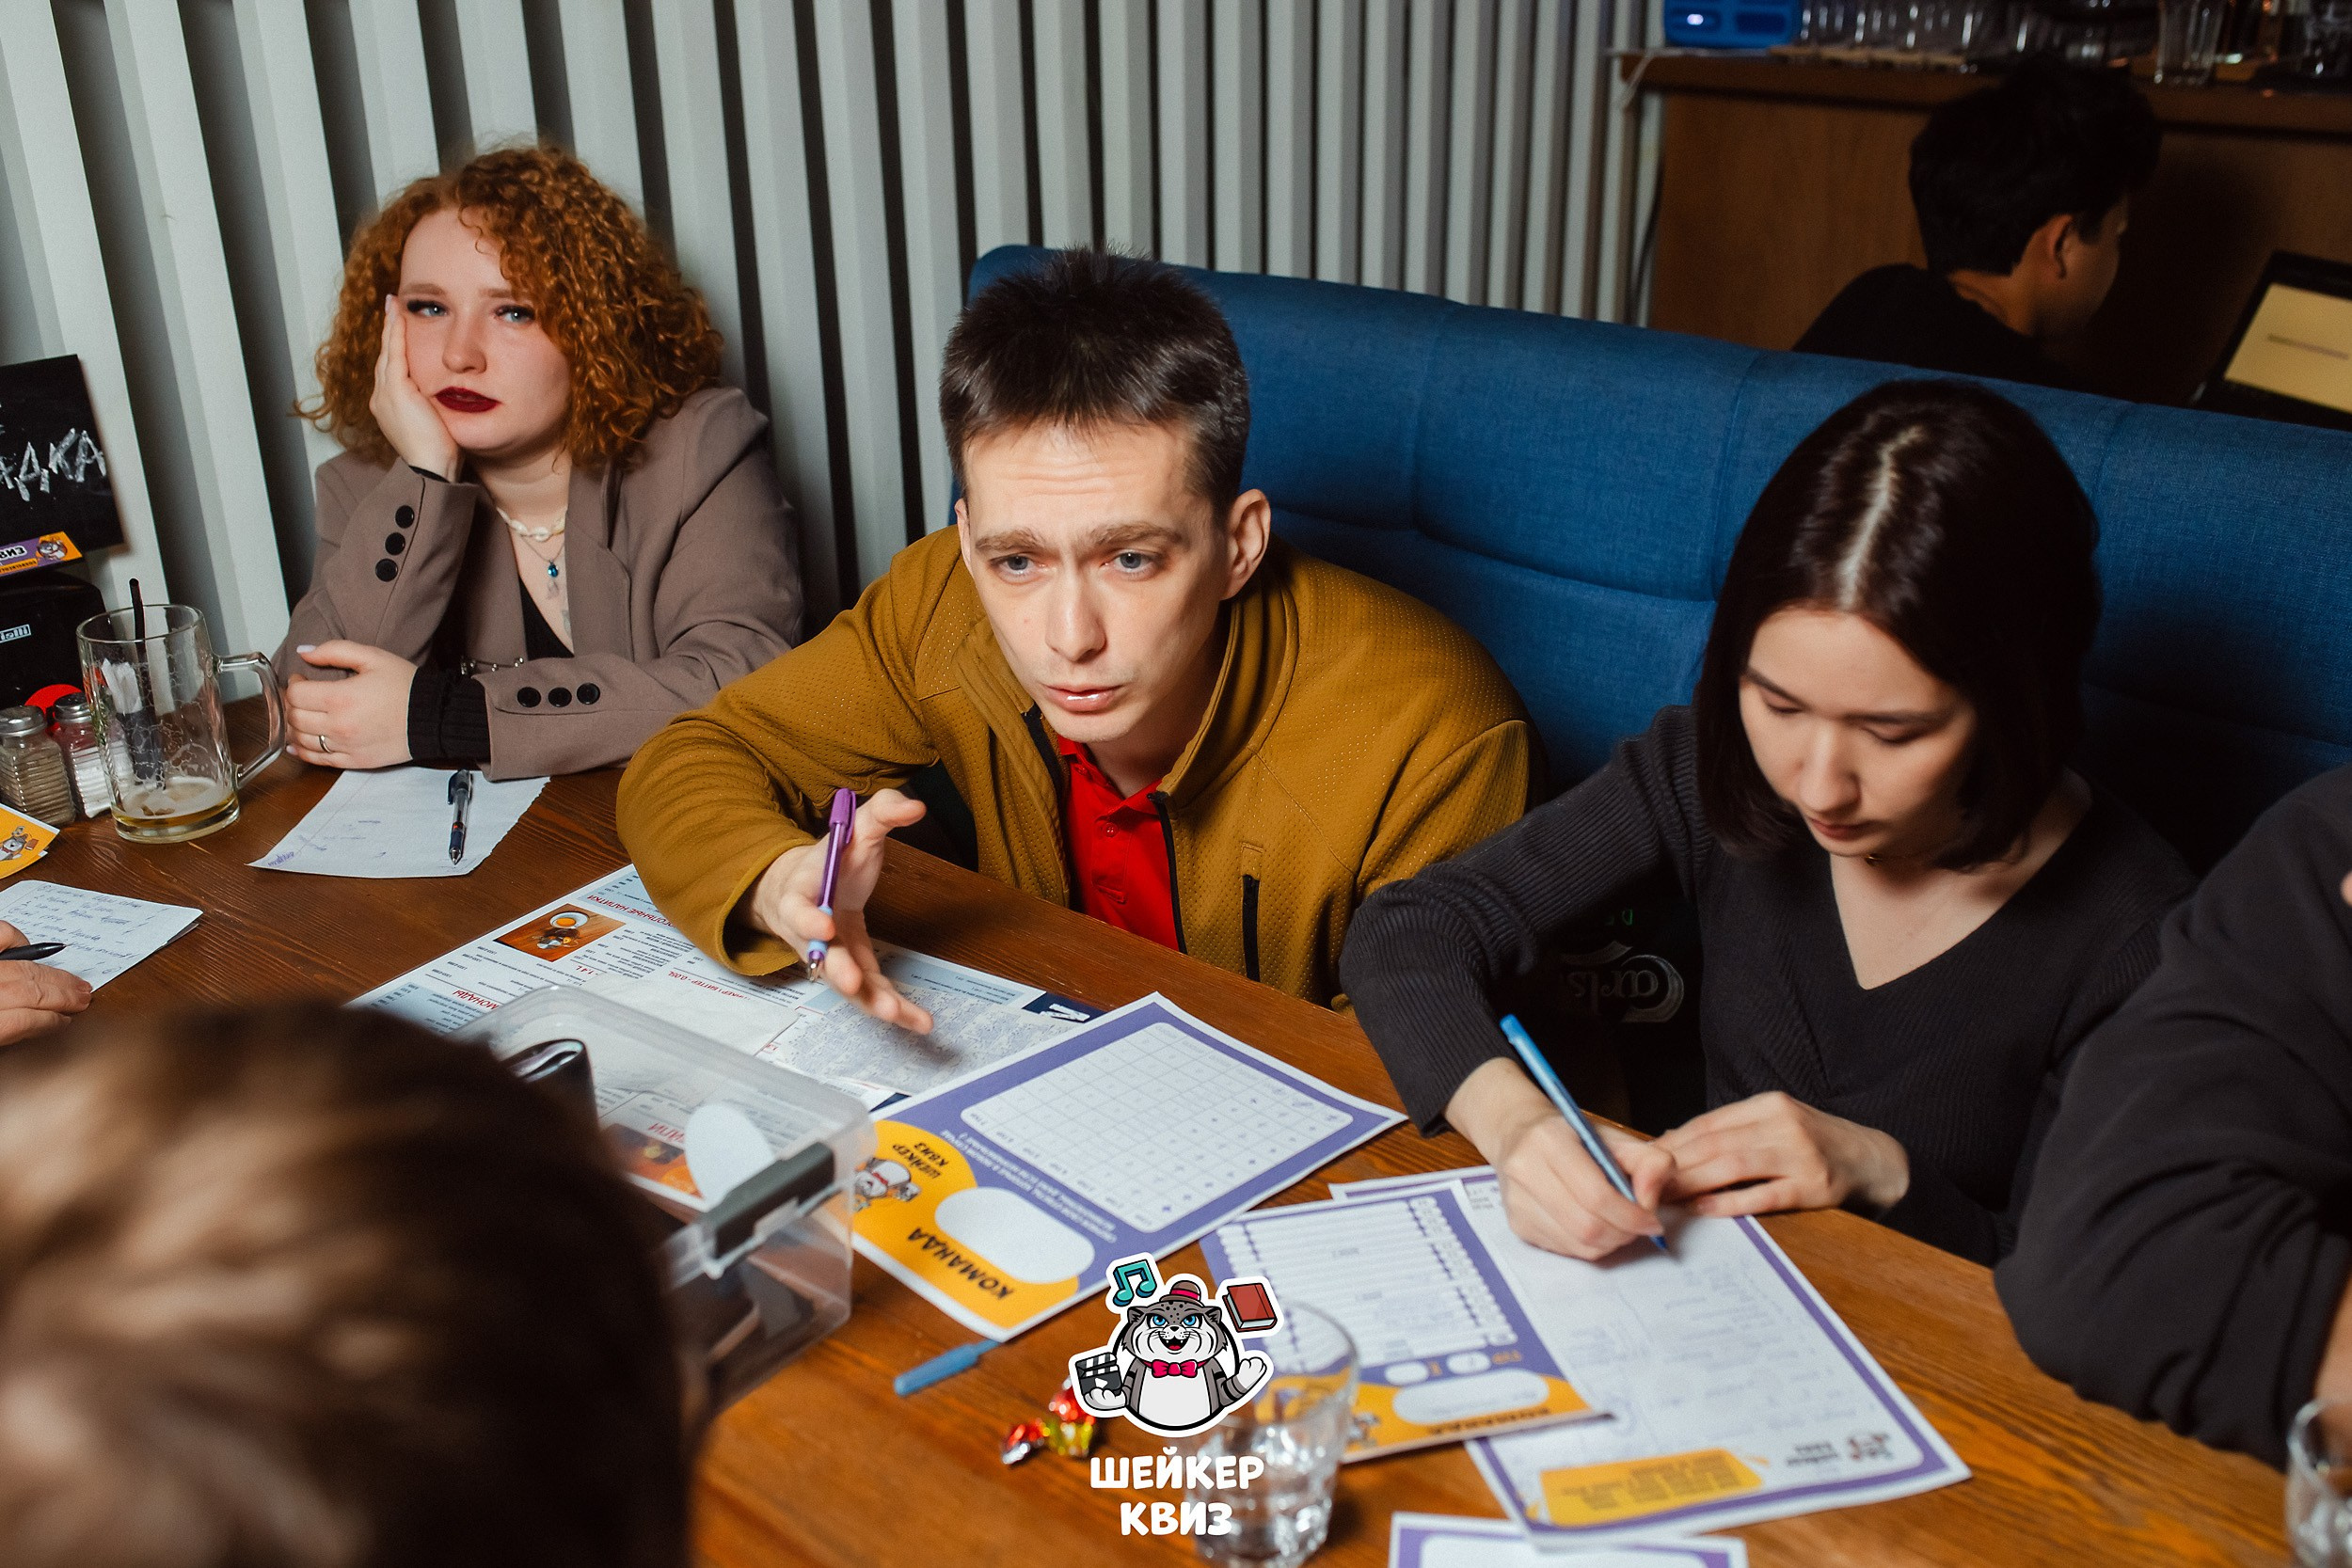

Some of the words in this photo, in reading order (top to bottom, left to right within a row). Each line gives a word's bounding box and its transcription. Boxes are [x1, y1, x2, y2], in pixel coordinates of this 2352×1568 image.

[628, 907, 677, 928] ОГОЛЬНЫЕ
[453, 990, 500, 1010] МОНАДЫ
[1565, 955, 1684, 1023] Carls
[892, 1143, 941, 1180] ШЕЙКЕР
[914, 1142, 948, 1167] КВИЗ
[907, 1227, 1013, 1299] КОМАНДА
